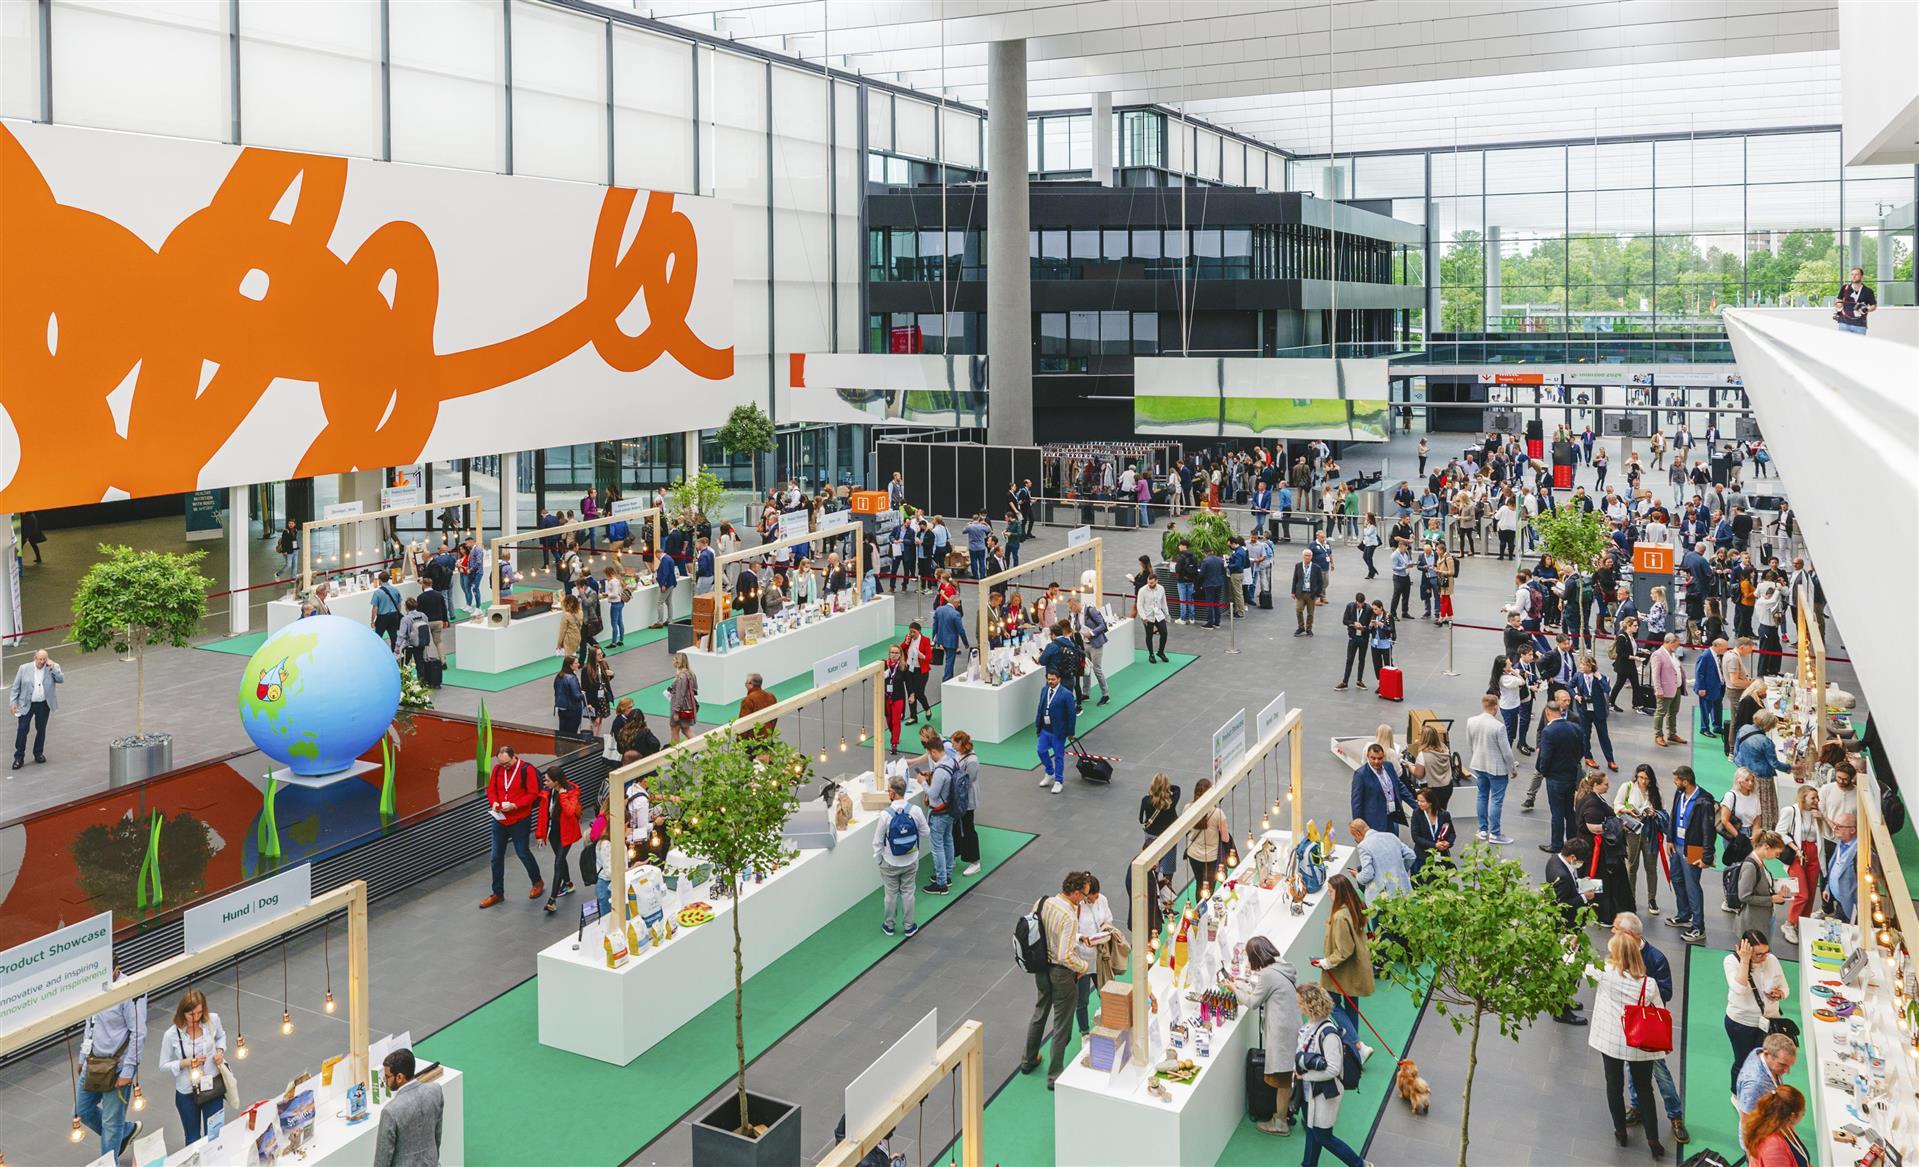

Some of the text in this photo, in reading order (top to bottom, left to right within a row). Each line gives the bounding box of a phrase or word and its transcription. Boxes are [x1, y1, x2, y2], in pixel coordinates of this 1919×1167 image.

[222, 904, 250, 923] Hund
[258, 894, 279, 909] Dog
[0, 928, 107, 974] Product Showcase
[41, 988, 58, 1001] und
[60, 967, 107, 992] inspirierend
[46, 976, 61, 988] and
[64, 961, 99, 979] inspiring
